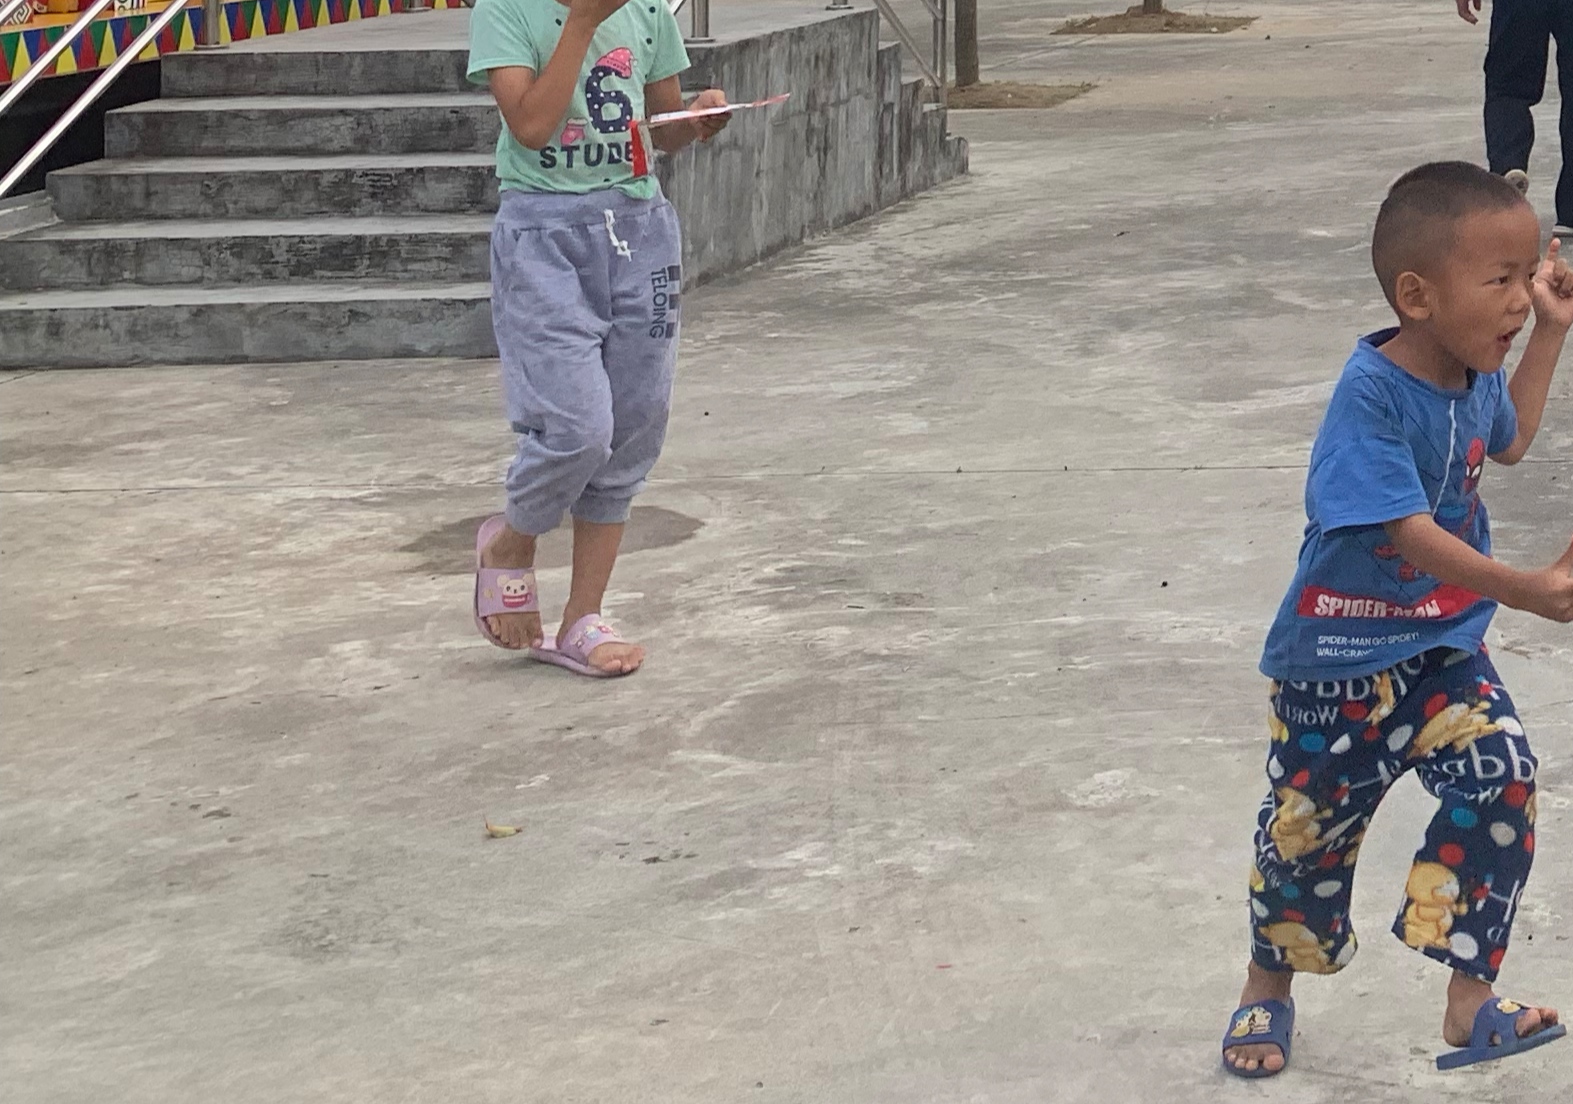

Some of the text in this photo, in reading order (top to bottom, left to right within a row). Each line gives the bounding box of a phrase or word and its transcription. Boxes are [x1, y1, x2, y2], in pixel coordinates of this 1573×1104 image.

[585, 64, 633, 134] 6
[649, 266, 668, 339] TELOING
[1318, 635, 1371, 647] SPIDER-MAN
[1371, 636, 1387, 647] GO
